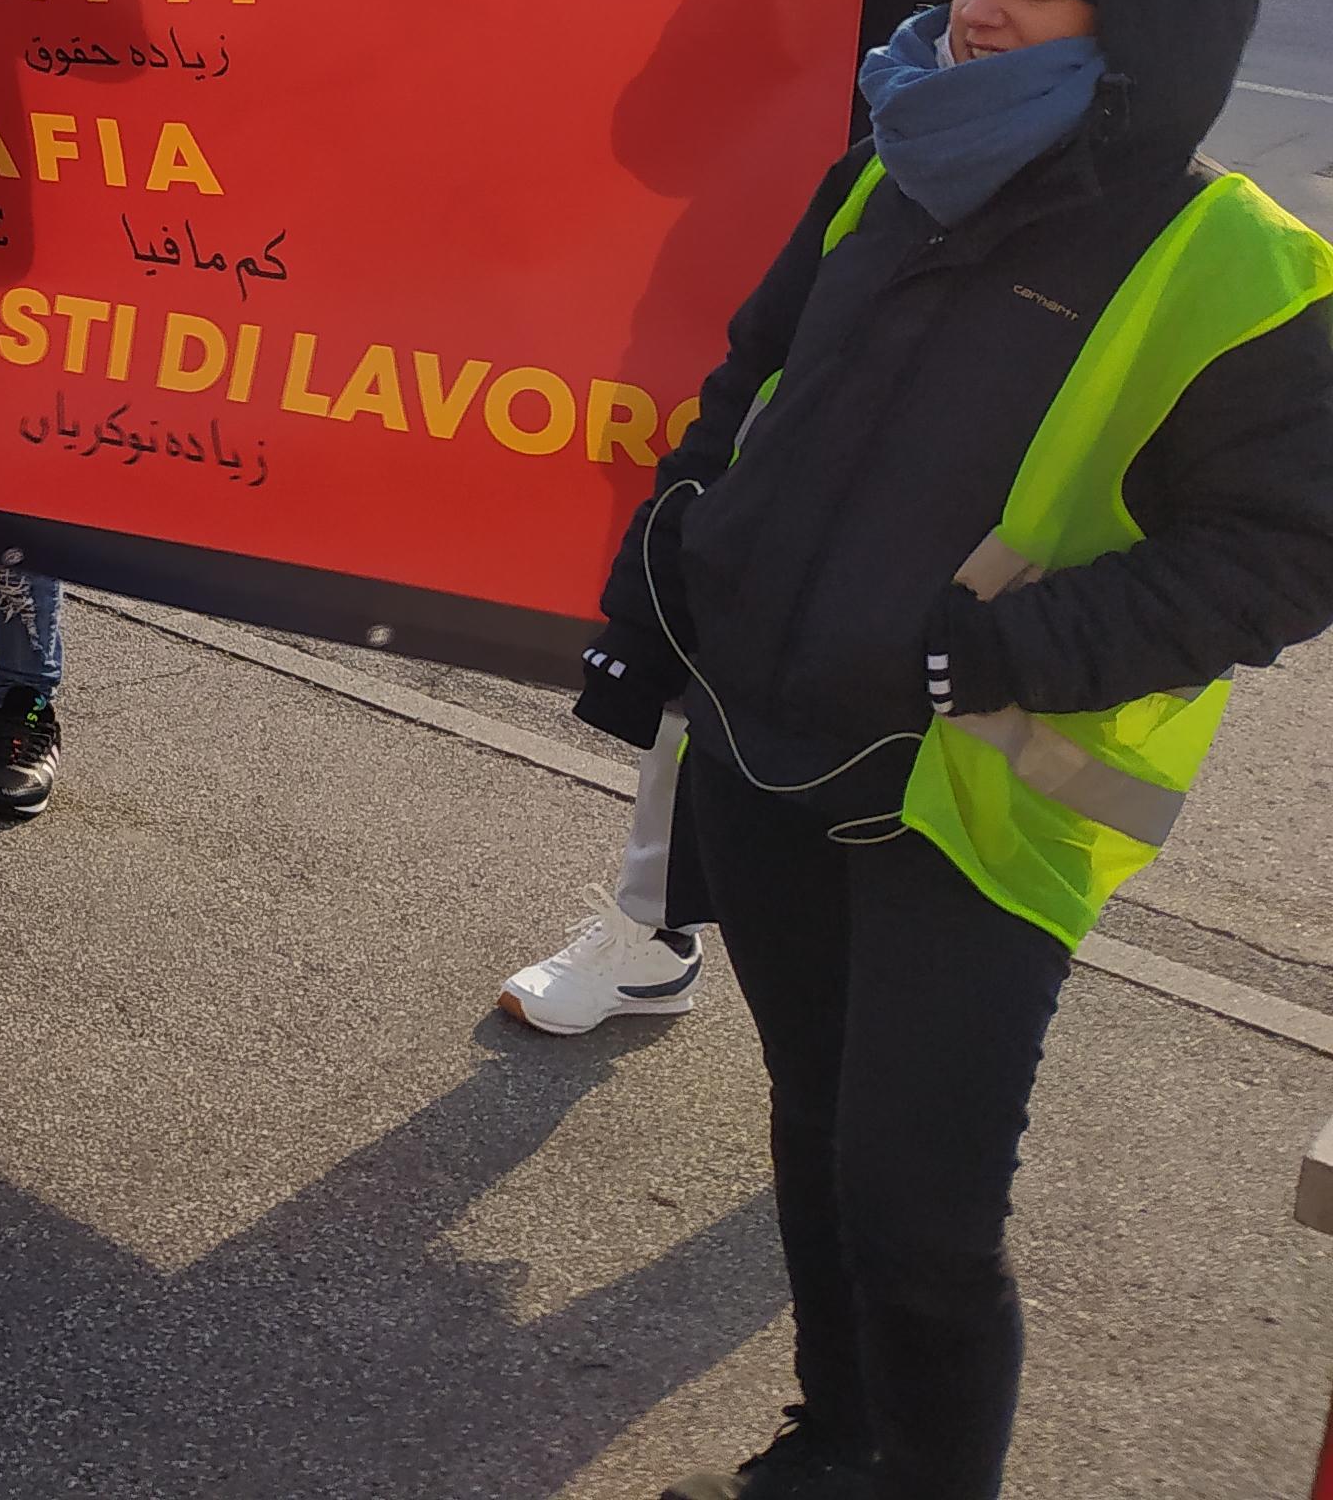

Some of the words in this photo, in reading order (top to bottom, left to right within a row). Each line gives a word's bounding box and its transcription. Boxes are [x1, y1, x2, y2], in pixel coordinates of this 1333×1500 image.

[25, 35, 121, 77] حقوق
[1012, 283, 1080, 322] carhartt
[159, 310, 261, 404] DI
